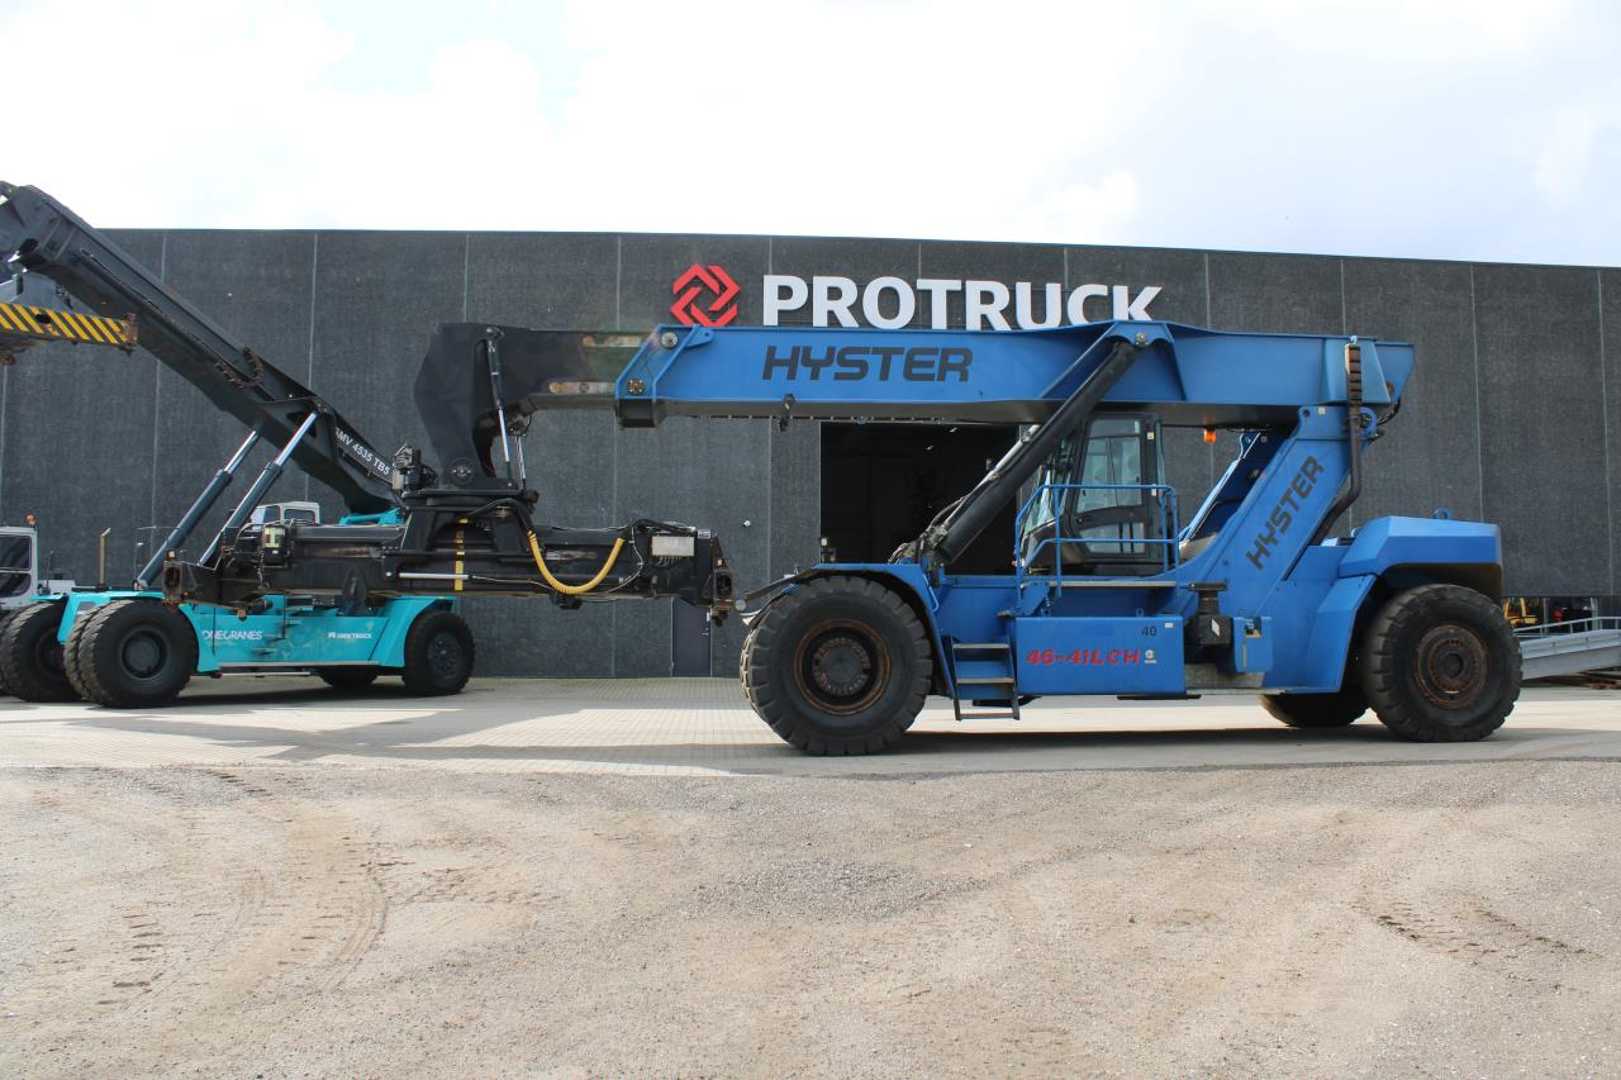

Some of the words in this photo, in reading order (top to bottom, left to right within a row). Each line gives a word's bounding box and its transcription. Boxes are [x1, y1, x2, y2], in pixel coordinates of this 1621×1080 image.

[762, 274, 1163, 332] PROTRUCK
[762, 345, 974, 382] HYSTER
[1245, 455, 1326, 571] HYSTER
